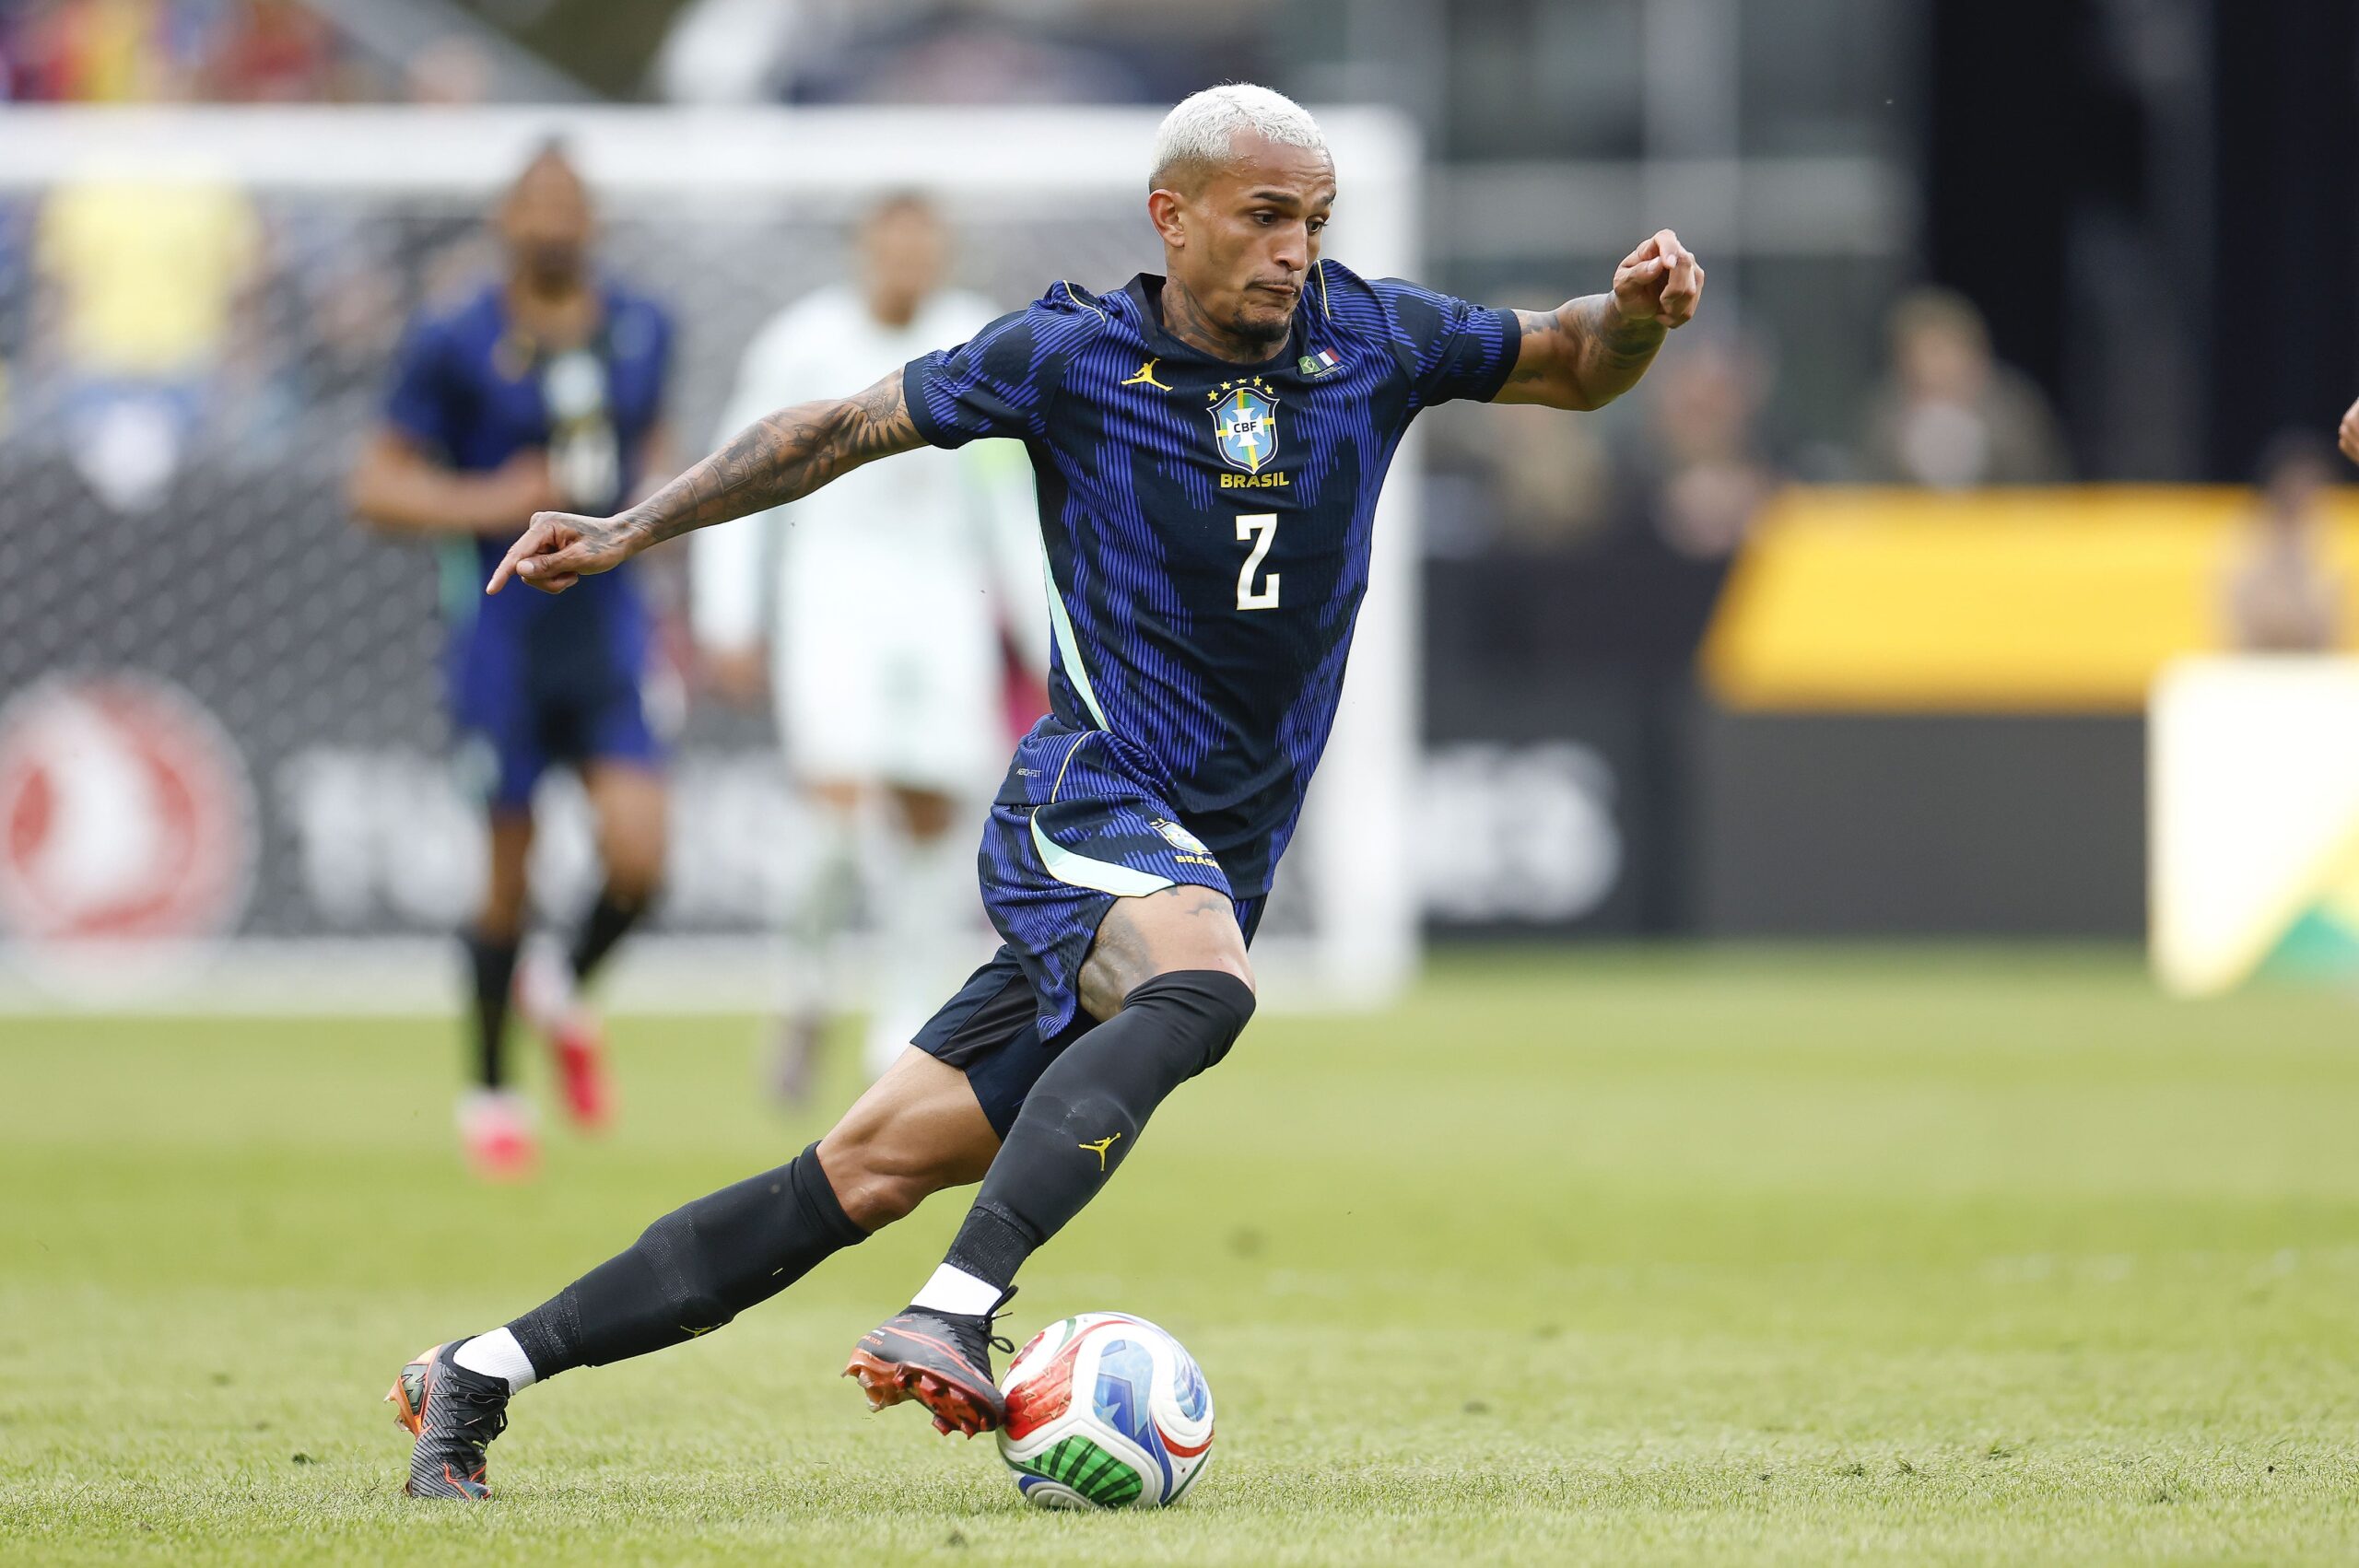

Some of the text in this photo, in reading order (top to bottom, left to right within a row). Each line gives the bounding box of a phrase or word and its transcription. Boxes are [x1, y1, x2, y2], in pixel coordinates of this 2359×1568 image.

[1233, 421, 1257, 433] CBF
[1220, 472, 1290, 488] BRASIL
[1236, 513, 1280, 610] 2
